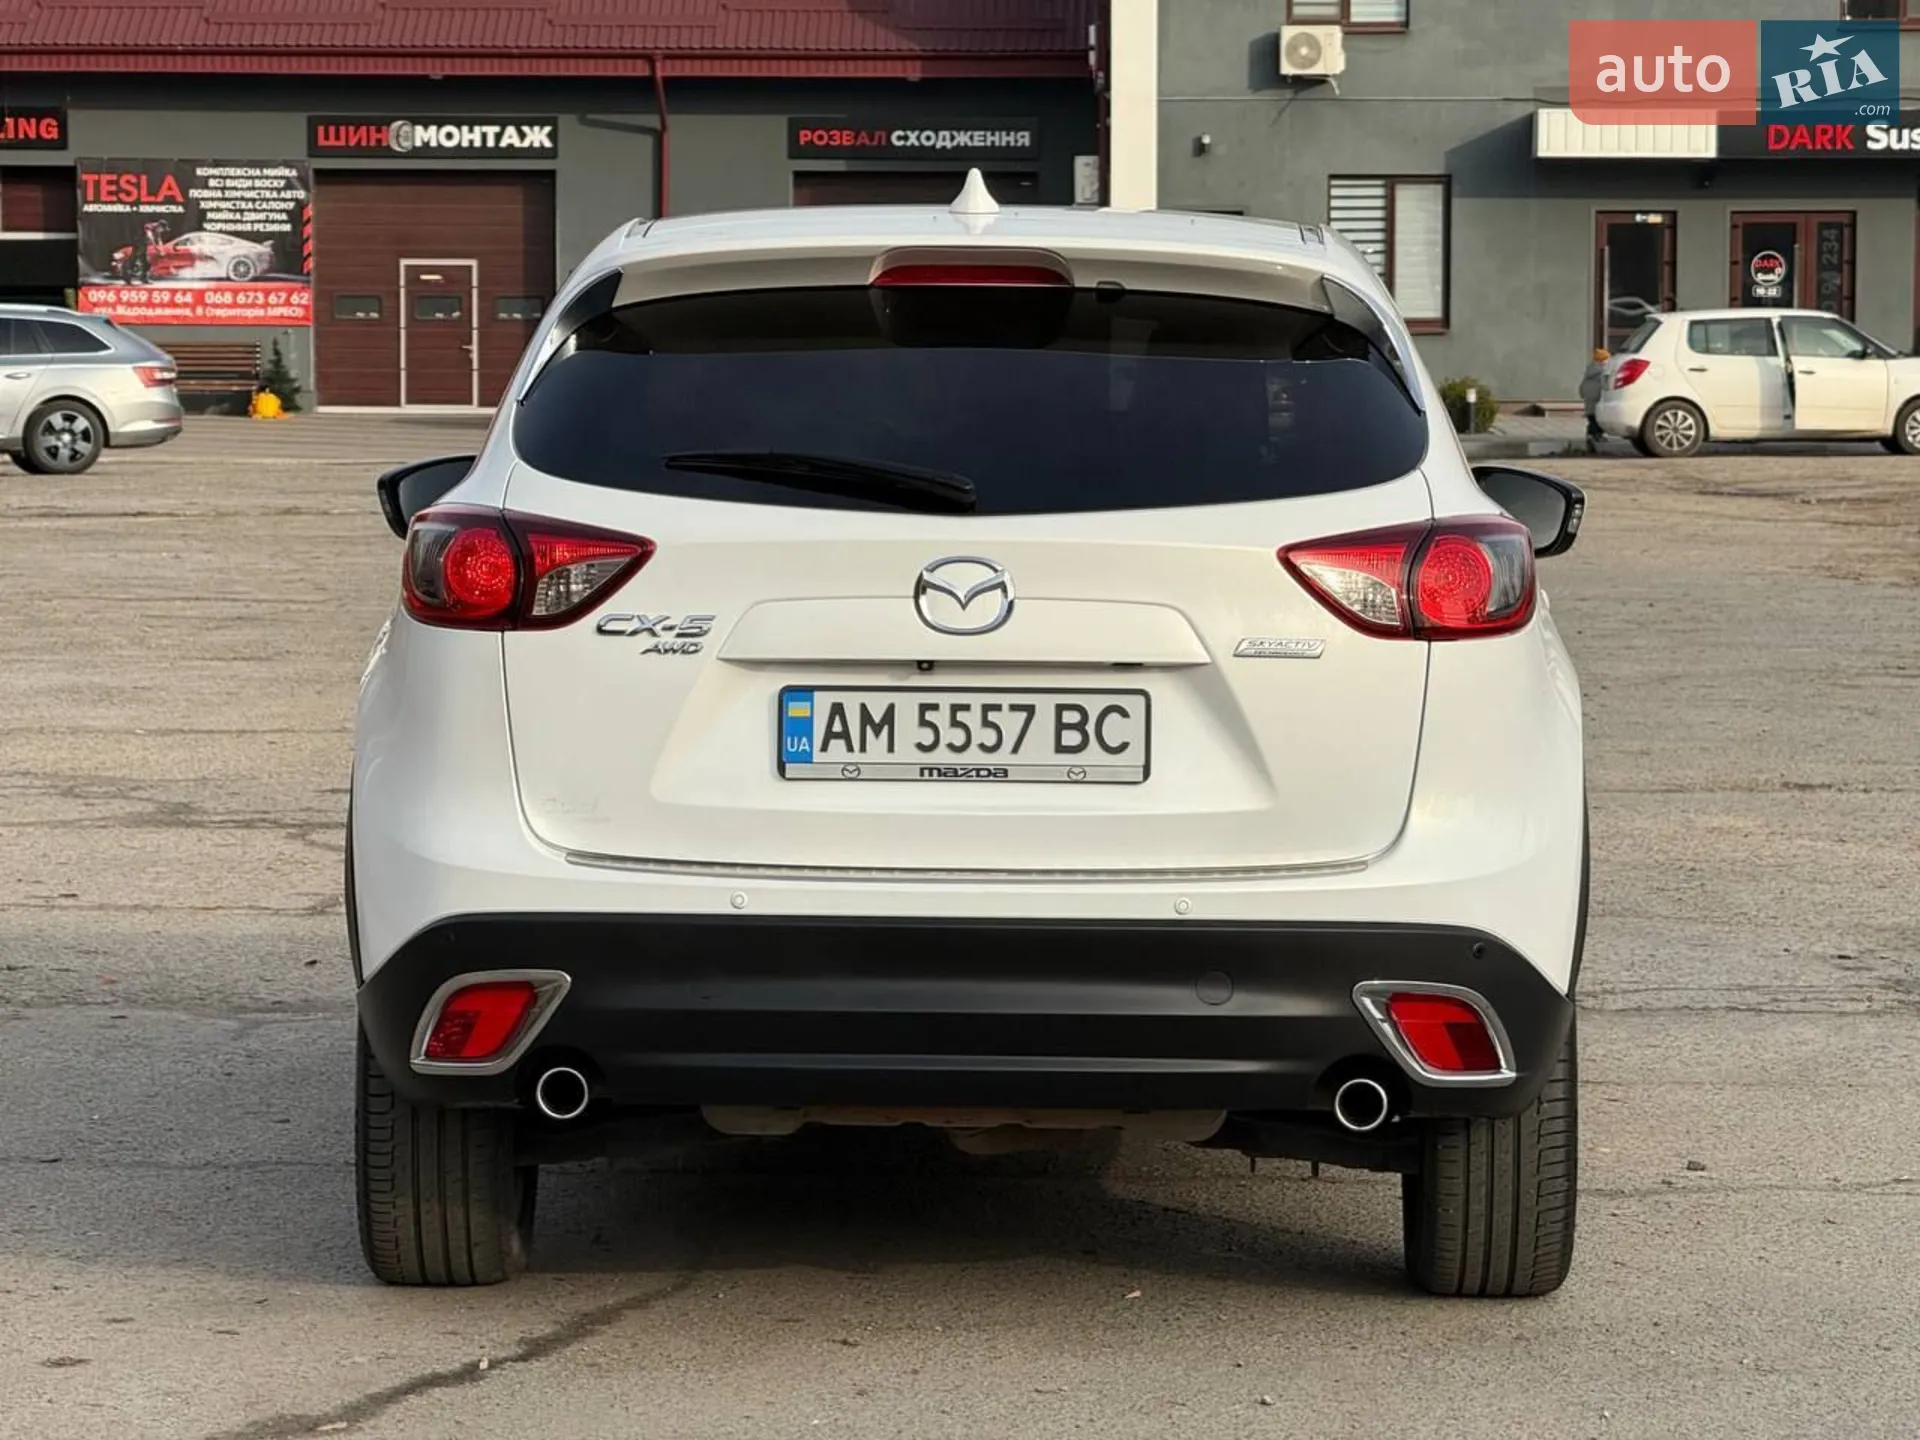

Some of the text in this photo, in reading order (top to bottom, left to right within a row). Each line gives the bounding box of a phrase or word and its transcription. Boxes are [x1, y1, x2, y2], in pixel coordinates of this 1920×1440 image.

[0, 117, 59, 140] ING
[799, 129, 1031, 149] РОЗВАЛ СХОДЖЕННЯ
[1767, 124, 1856, 150] DARK
[195, 166, 298, 177] КОМПЛЕКСНА МИЙКА
[82, 173, 184, 202] TESLA
[254, 178, 287, 188] ВОСКУ
[188, 189, 223, 198] ПОВНА
[279, 189, 306, 199] АВТО
[254, 200, 296, 210] САЛОНУ
[206, 210, 289, 221] МИЙКА ДВИГУНА
[87, 289, 117, 303] 096
[120, 289, 149, 303] 959
[152, 290, 171, 304] 59
[236, 291, 266, 305] 673
[268, 291, 288, 305] 67
[290, 291, 309, 305] 62
[596, 613, 716, 638] CX-5
[640, 640, 704, 655] AWD
[1246, 640, 1317, 649] SKYACTIV
[819, 702, 1132, 756] AM 5557 BC
[787, 736, 811, 753] UA
